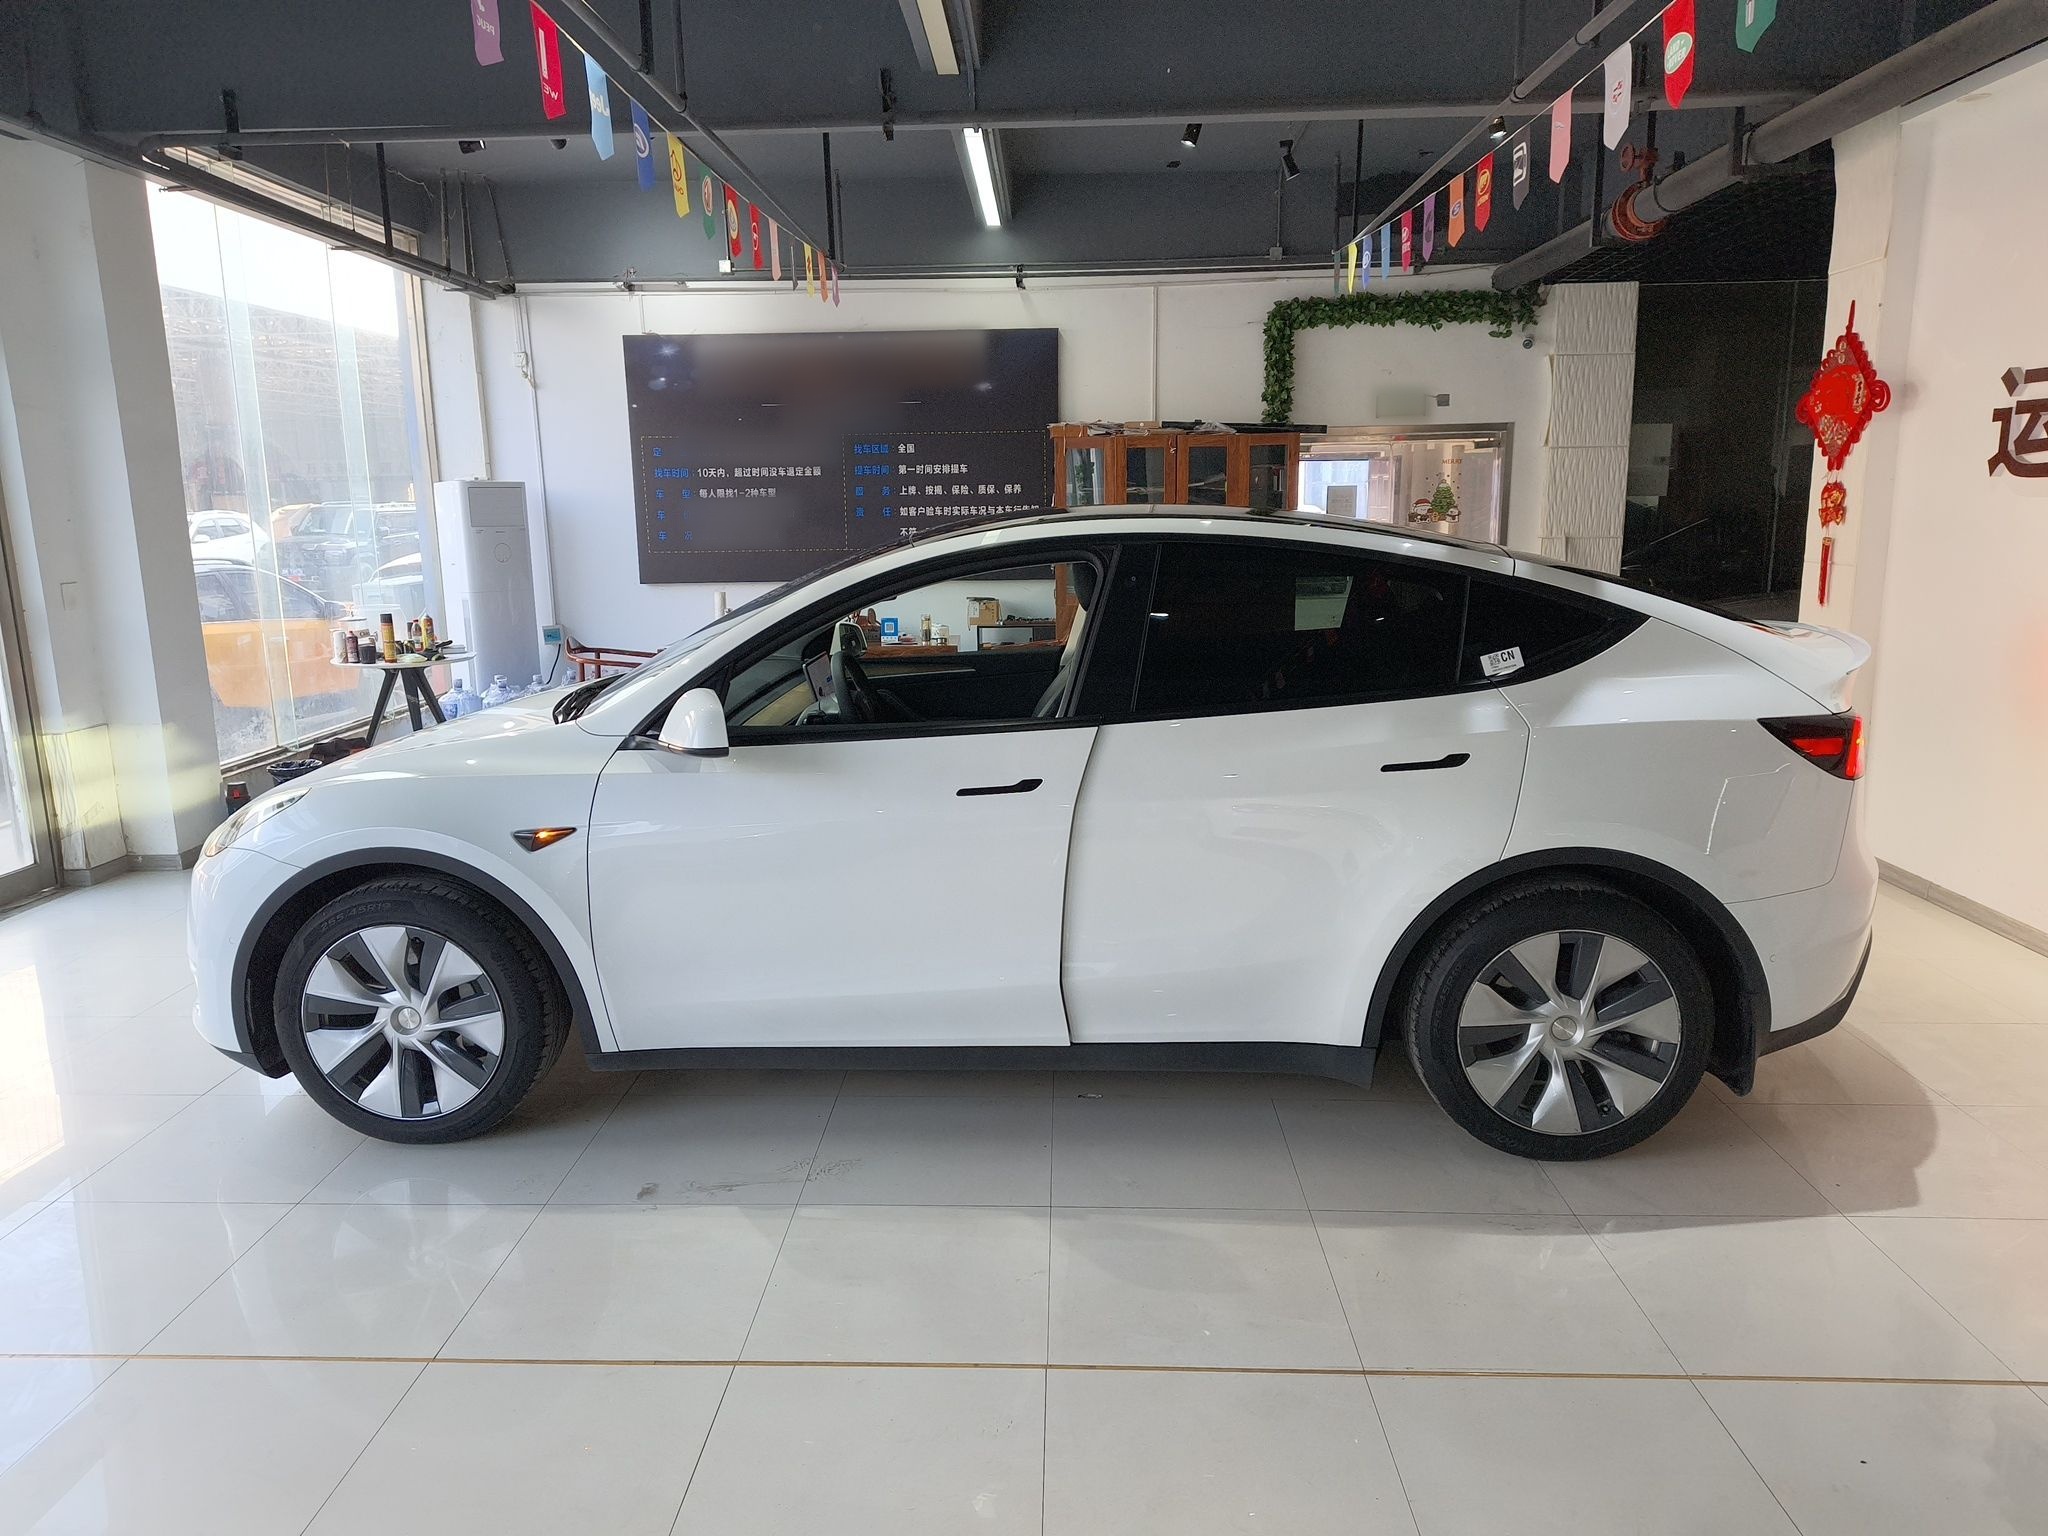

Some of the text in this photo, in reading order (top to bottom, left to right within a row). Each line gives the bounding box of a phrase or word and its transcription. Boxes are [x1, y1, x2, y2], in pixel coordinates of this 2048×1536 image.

[898, 443, 915, 454] 全国
[898, 463, 968, 475] 第一时间安排提车
[1500, 649, 1516, 663] CN
